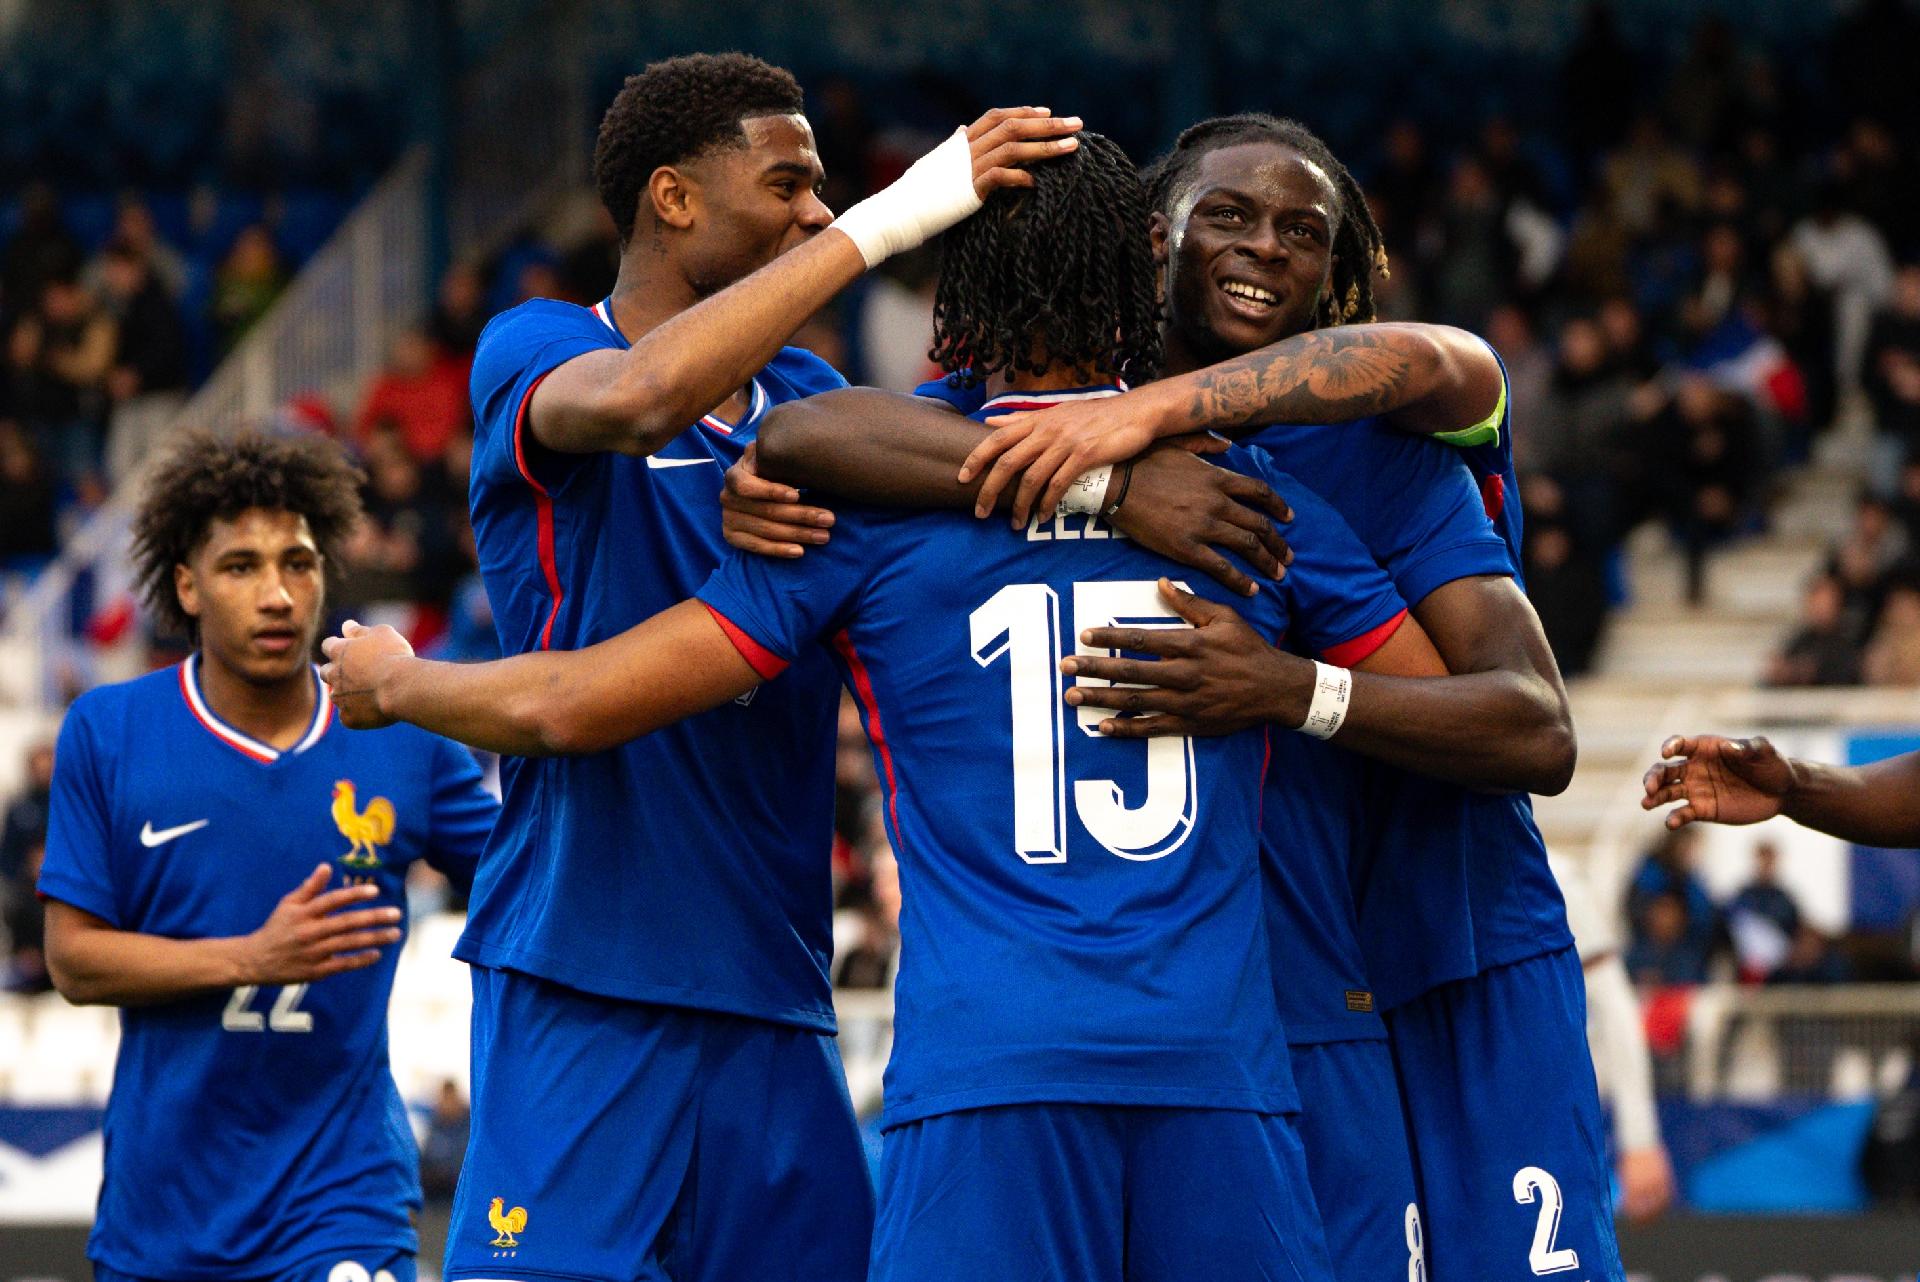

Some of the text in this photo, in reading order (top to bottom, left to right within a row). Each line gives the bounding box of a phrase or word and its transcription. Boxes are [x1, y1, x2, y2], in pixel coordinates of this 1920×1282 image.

[969, 580, 1198, 864] 15
[222, 983, 314, 1032] 22
[1405, 1202, 1427, 1282] 8
[1512, 1166, 1579, 1275] 2
